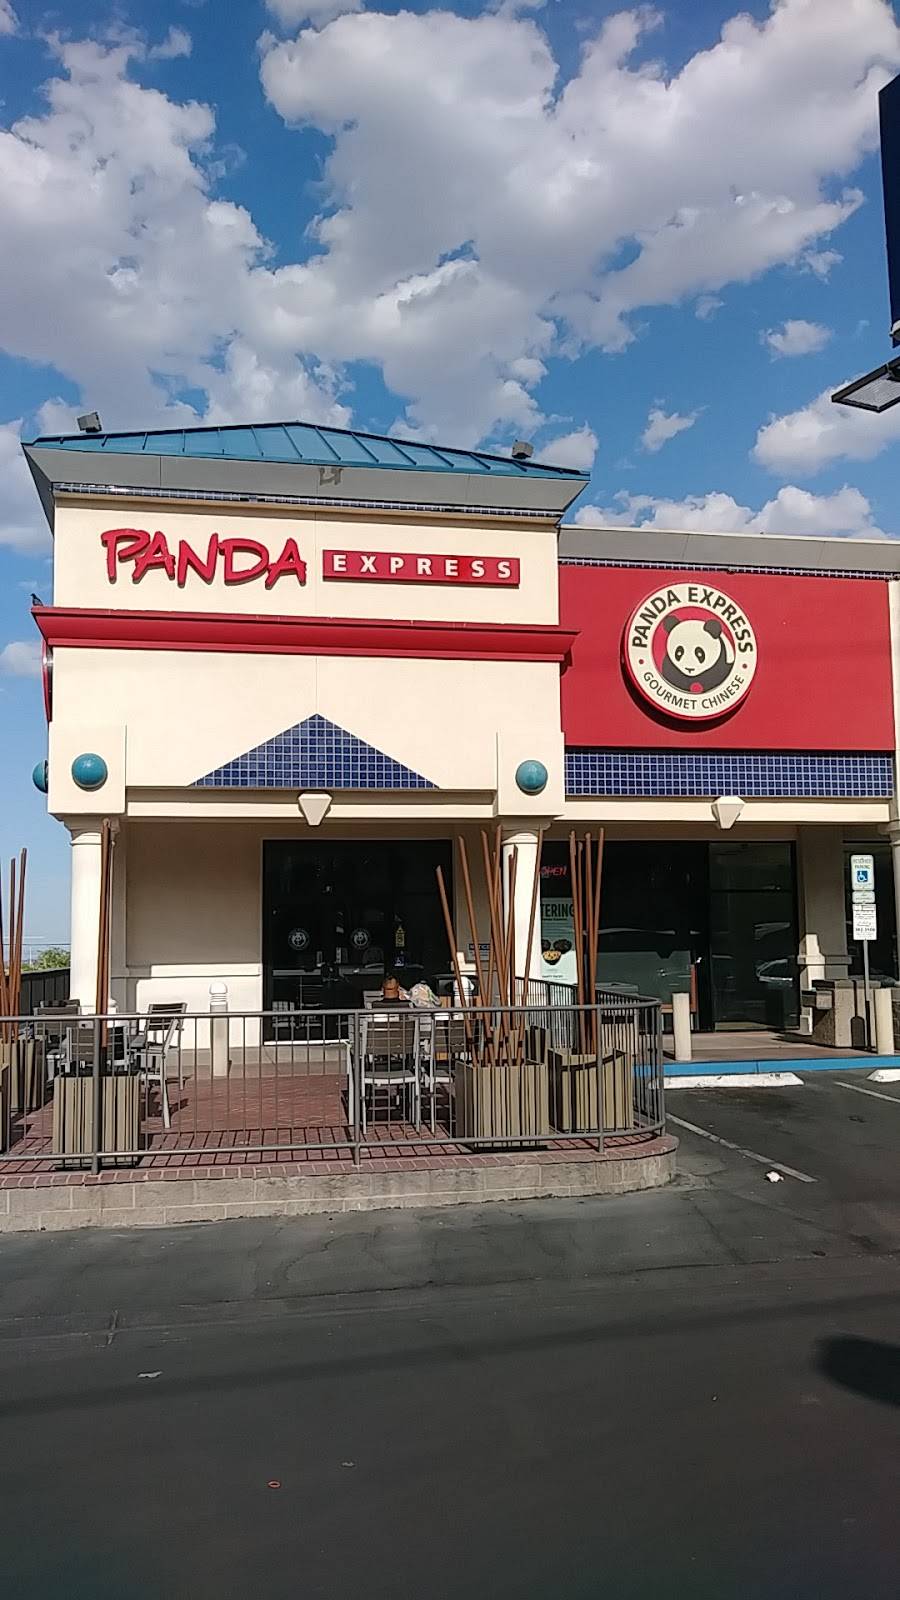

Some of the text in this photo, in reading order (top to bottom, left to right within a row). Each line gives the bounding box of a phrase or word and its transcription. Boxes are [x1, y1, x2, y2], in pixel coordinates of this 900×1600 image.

[101, 529, 512, 589] PANDA EXPRESS
[632, 586, 753, 653] PANDA EXPRESS
[643, 671, 744, 710] GOURMET CHINESE
